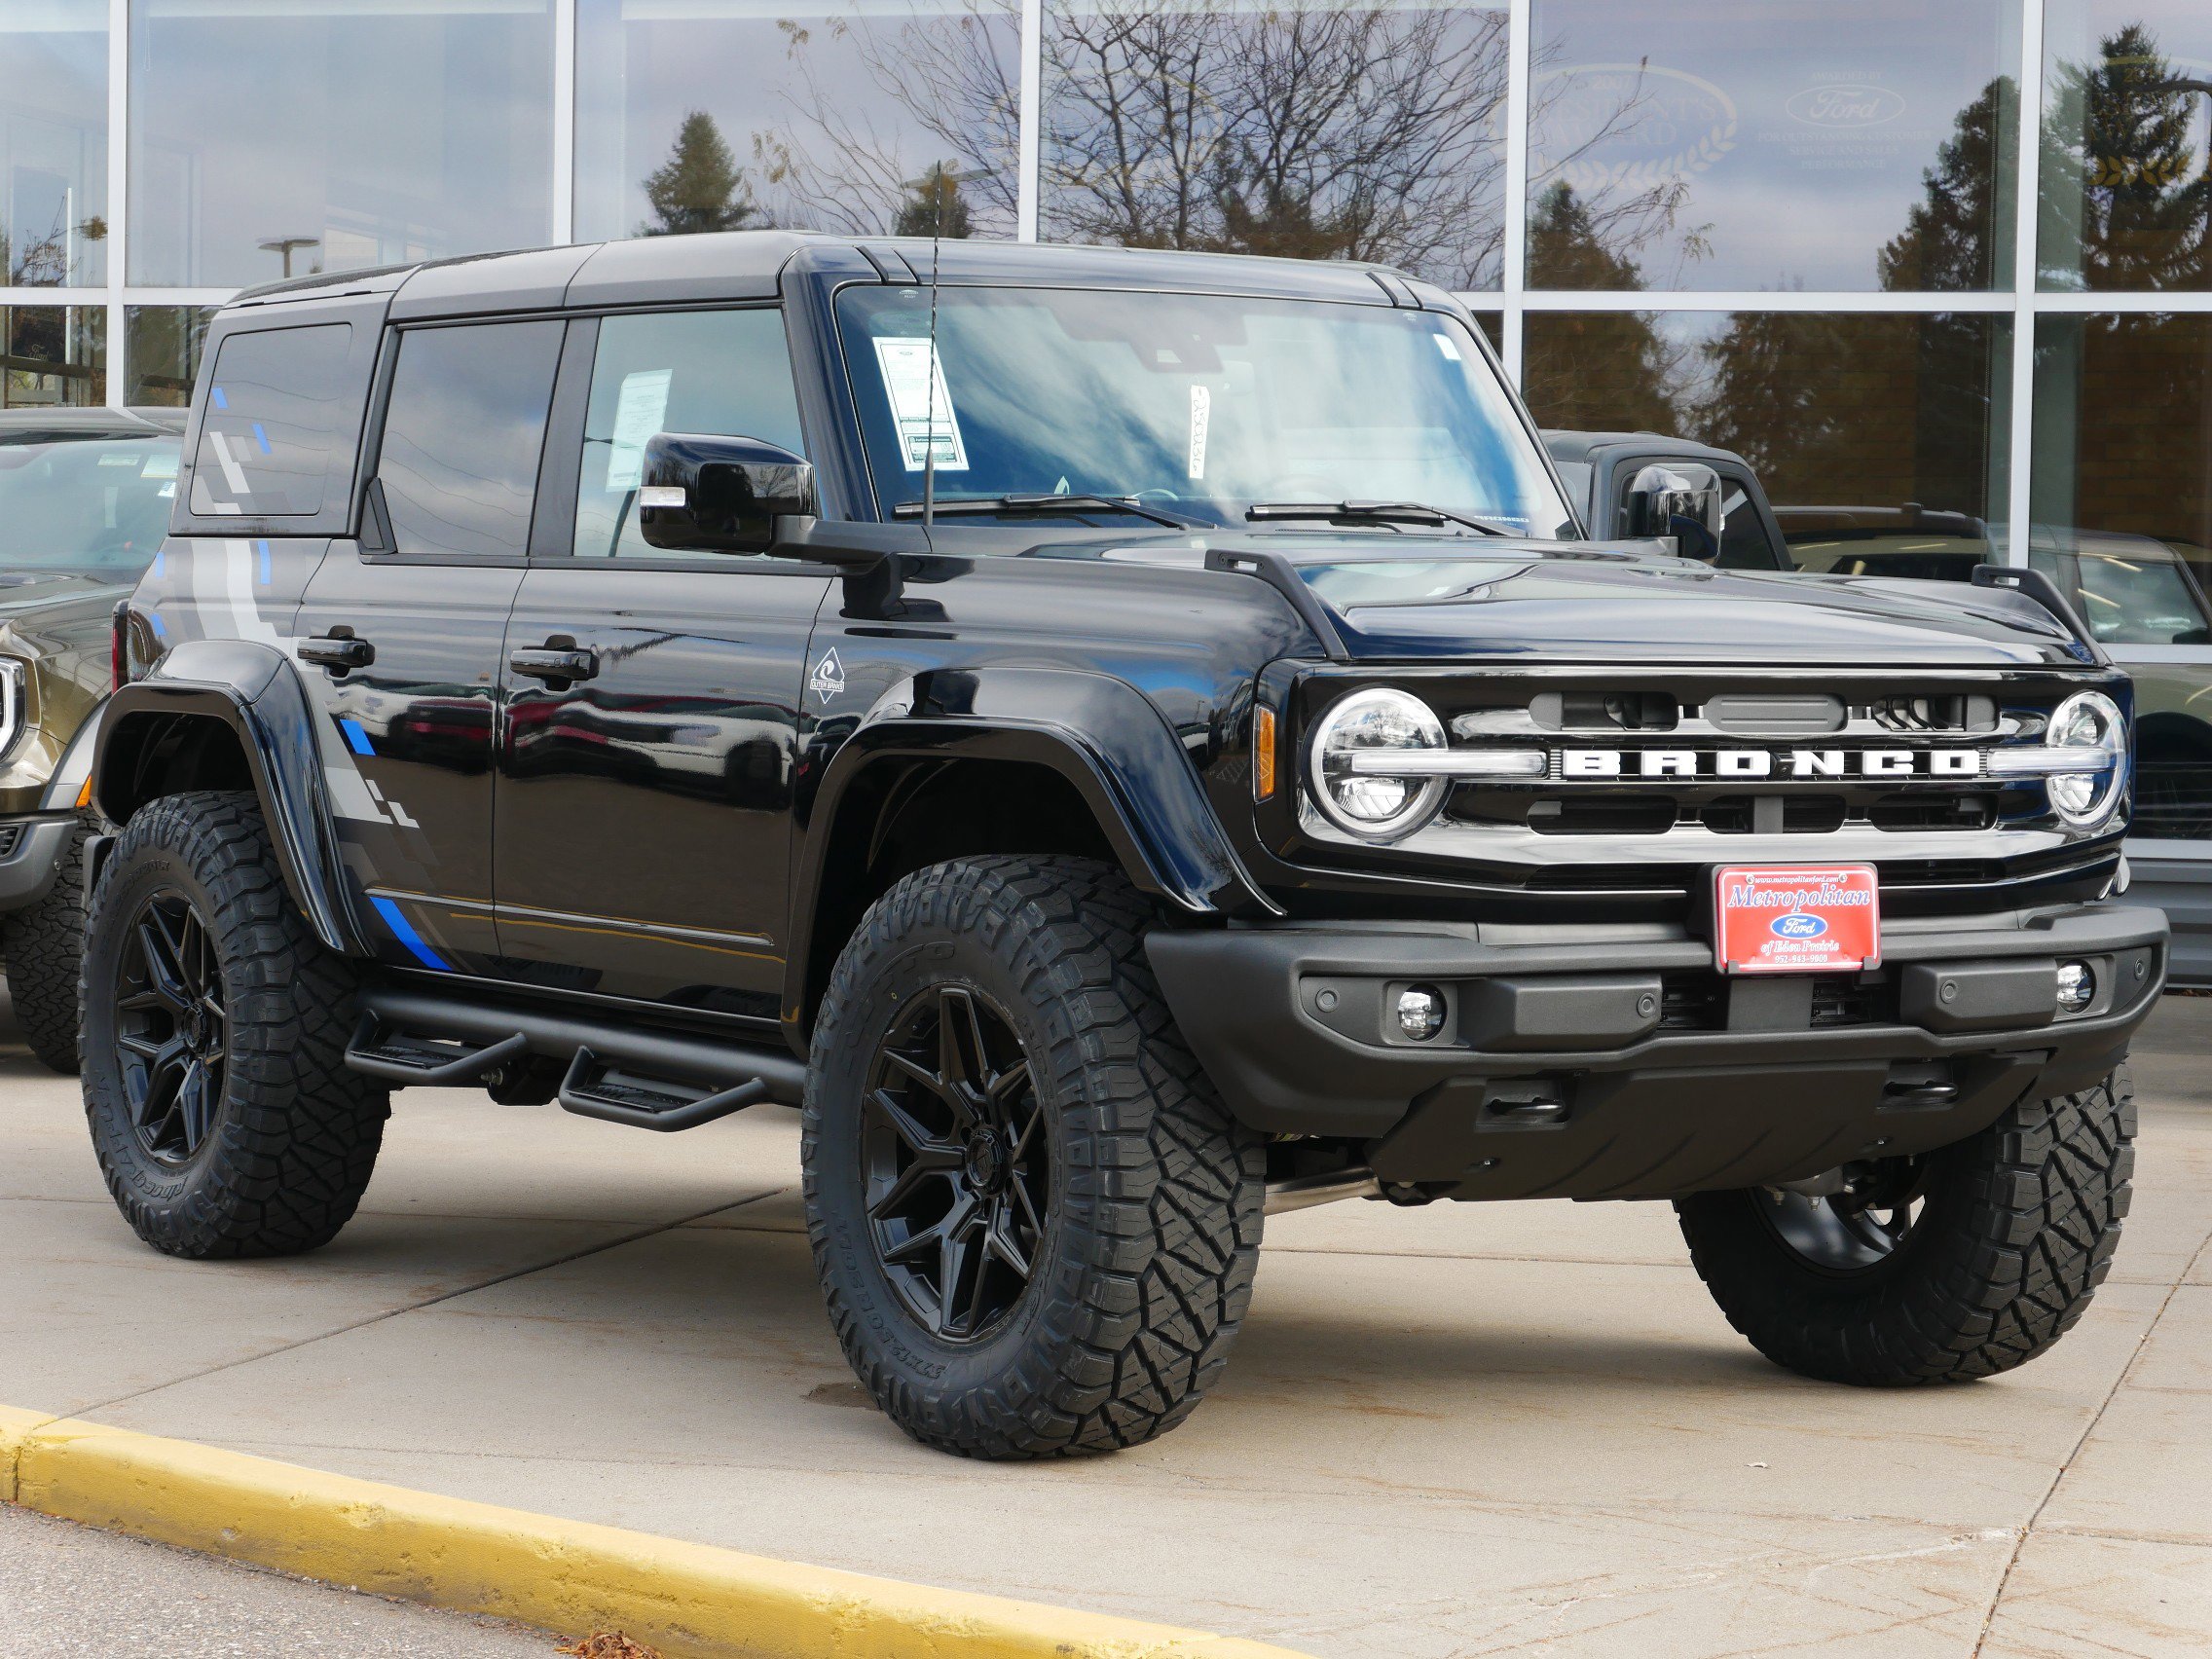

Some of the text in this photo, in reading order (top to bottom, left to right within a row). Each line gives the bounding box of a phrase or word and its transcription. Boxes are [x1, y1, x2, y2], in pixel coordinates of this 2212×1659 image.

[1809, 90, 1881, 119] Ford
[1562, 750, 1979, 777] BRONCO
[1727, 882, 1871, 913] Metropolitan
[1783, 918, 1817, 935] Ford
[1760, 940, 1774, 955] of
